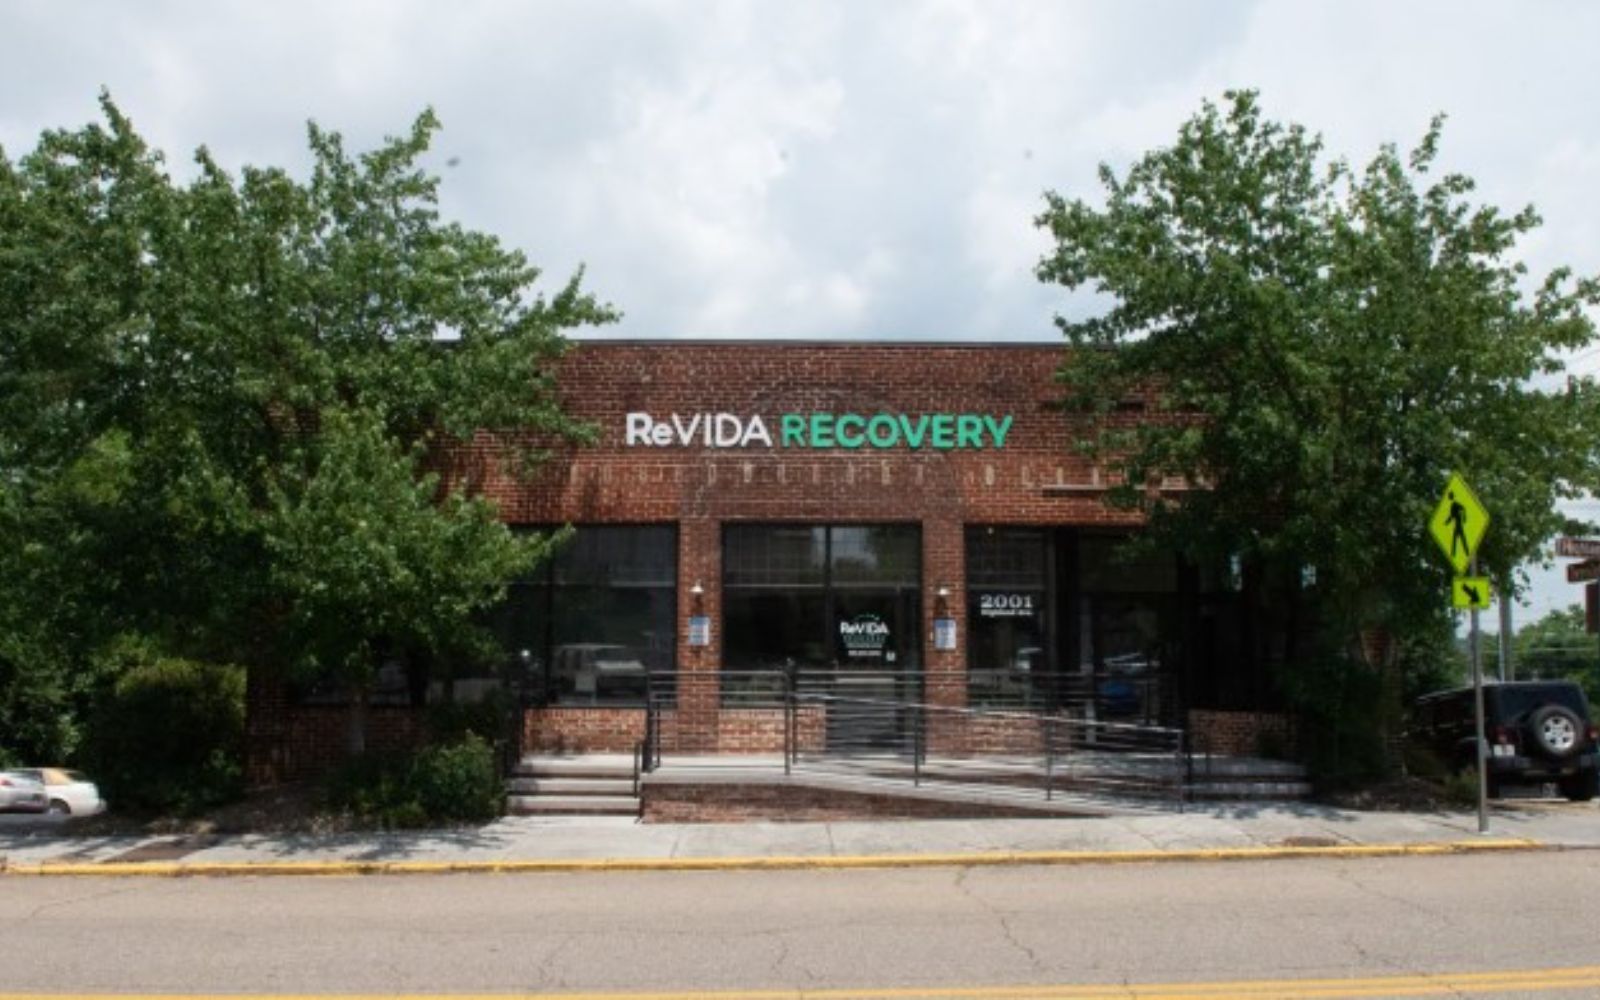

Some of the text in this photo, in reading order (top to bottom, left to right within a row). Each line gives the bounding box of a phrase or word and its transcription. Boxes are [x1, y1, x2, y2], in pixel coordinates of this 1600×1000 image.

[626, 412, 1012, 448] ReVIDA RECOVERY
[980, 594, 1033, 608] 2001
